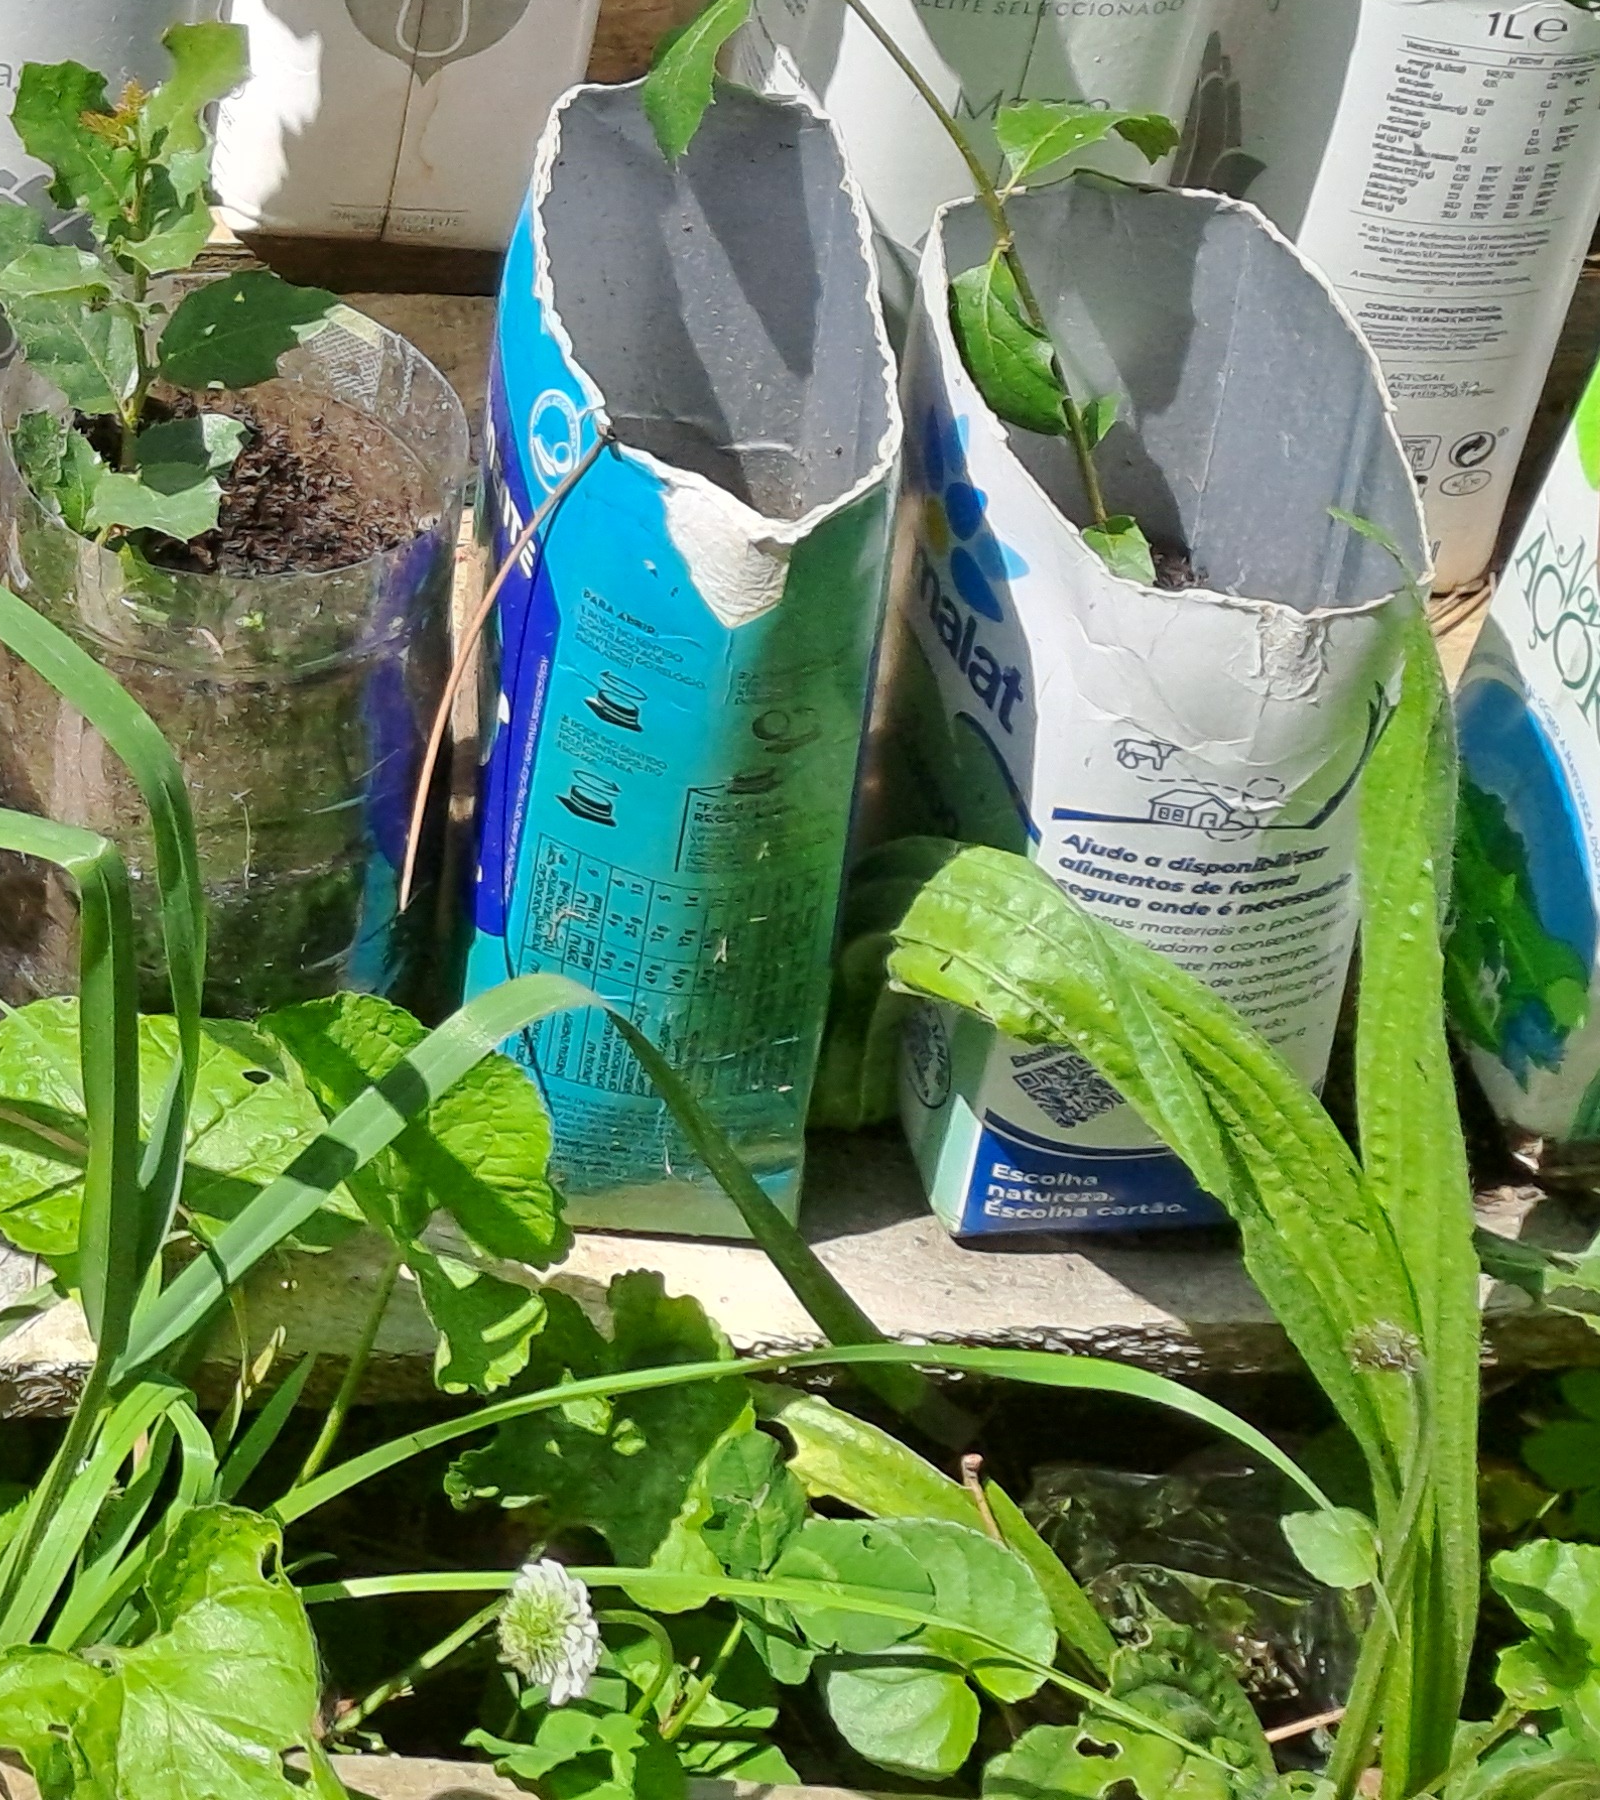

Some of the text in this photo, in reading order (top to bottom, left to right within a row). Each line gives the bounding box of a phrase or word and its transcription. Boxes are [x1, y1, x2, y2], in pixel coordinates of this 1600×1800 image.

[1488, 11, 1525, 40] 1L
[1062, 834, 1138, 864] Ajudo
[1144, 856, 1162, 868] a
[1059, 856, 1301, 895] alimentos de forma
[1056, 878, 1141, 908] segura
[1147, 899, 1211, 916] onde
[991, 1162, 1099, 1188] Escolhe
